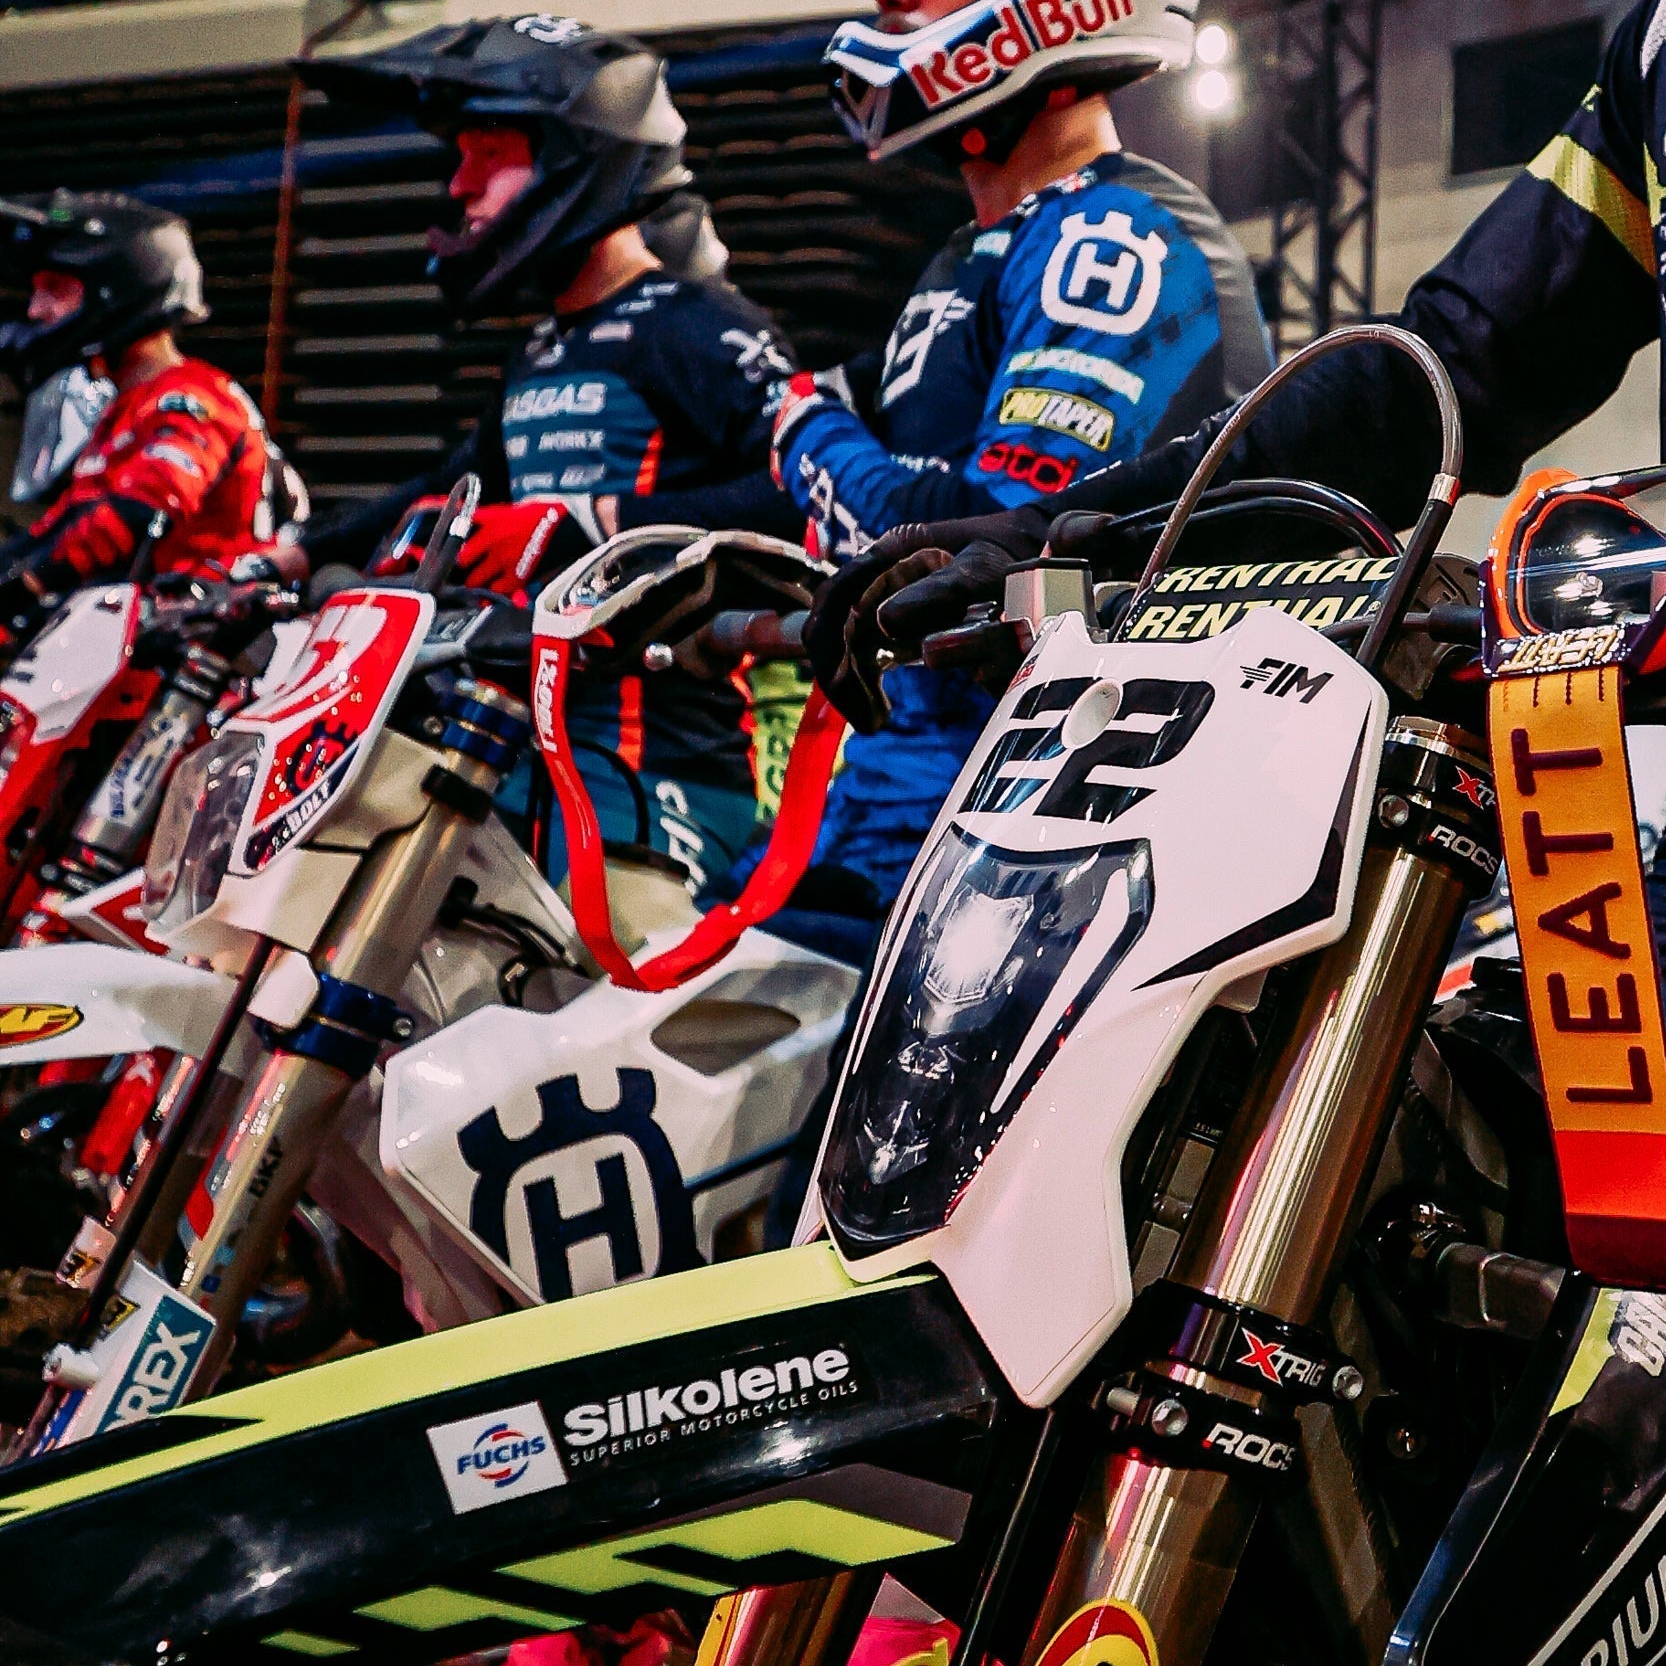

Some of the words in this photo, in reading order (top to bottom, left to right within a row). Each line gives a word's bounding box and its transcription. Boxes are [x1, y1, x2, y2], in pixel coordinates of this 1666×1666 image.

[911, 7, 1031, 106] Red
[1153, 555, 1400, 594] RENTHAL
[1240, 658, 1335, 704] FIM
[957, 676, 1215, 824] 22
[1511, 727, 1654, 1104] LEATT
[112, 1320, 202, 1430] REX
[563, 1347, 850, 1447] Silkolene
[1236, 1326, 1327, 1387] XTRIG
[457, 1434, 546, 1476] FUCHS
[570, 1429, 671, 1467] SUPERIOR
[681, 1394, 810, 1437] MOTORCYCLE
[818, 1380, 859, 1401] OILS
